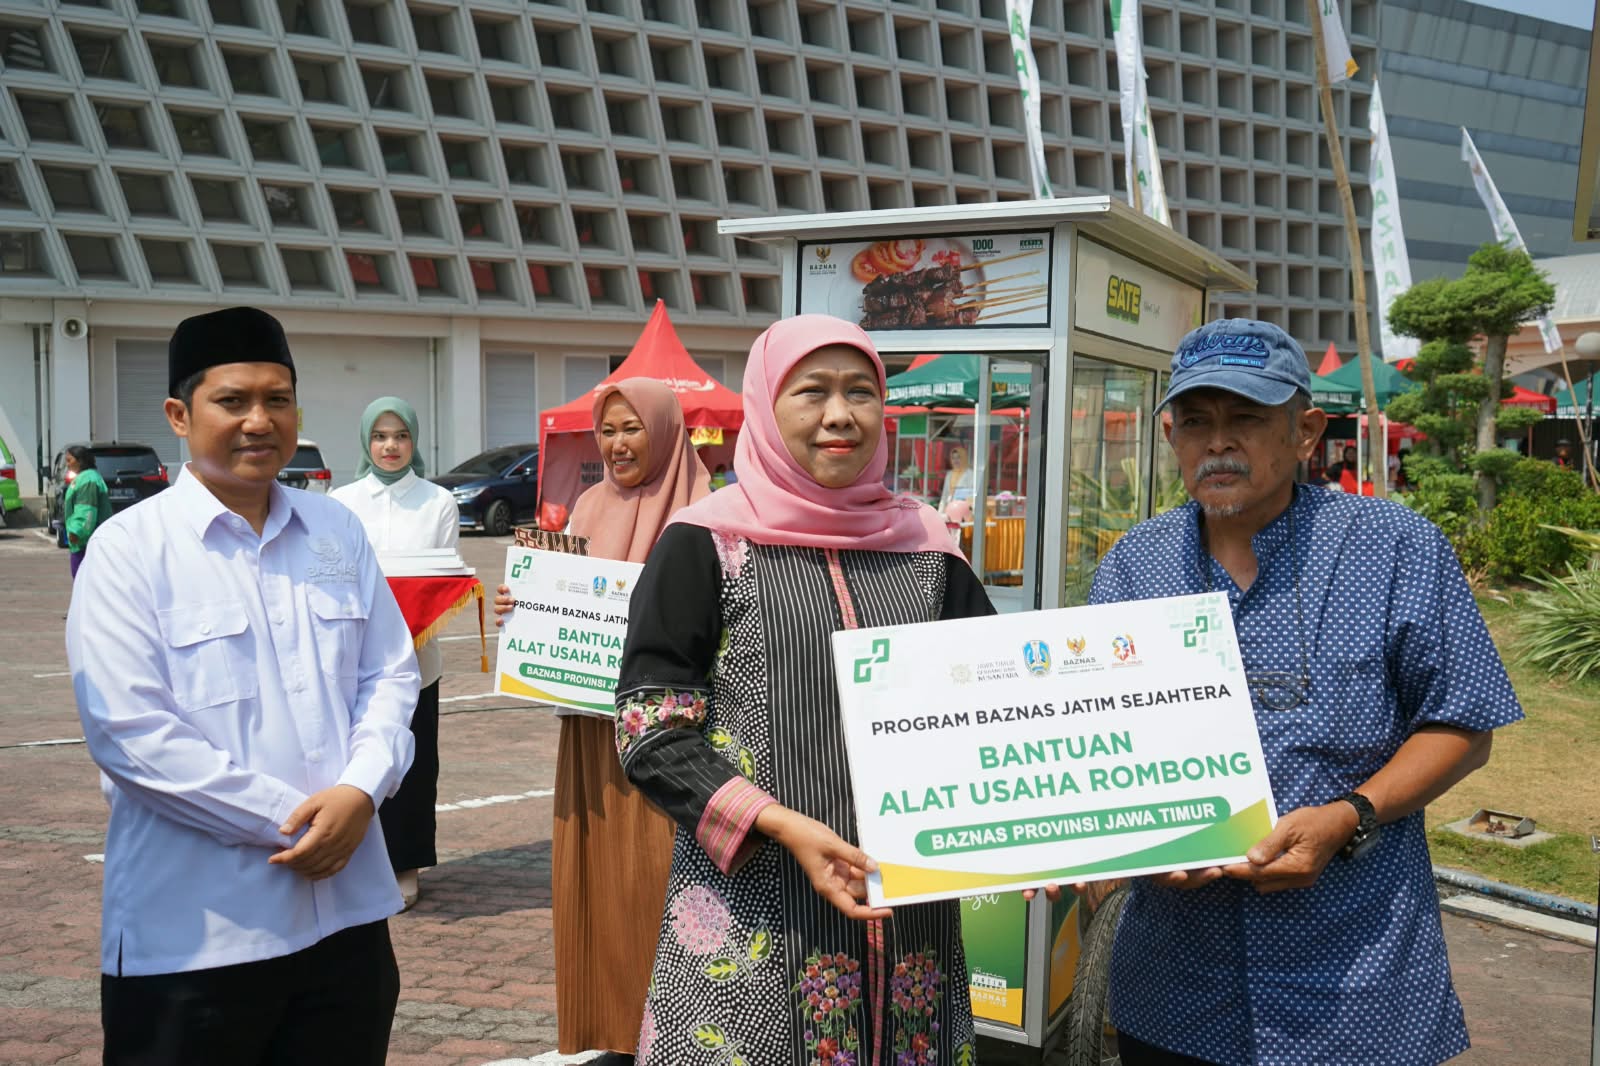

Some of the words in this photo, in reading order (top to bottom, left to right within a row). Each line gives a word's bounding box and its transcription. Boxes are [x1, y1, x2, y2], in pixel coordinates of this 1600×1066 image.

[972, 239, 994, 251] 1000
[1107, 275, 1141, 322] SATE
[513, 600, 560, 615] PROGRAM
[561, 607, 602, 621] BAZNAS
[507, 638, 546, 656] ALAT
[550, 645, 602, 666] USAHA
[558, 627, 625, 650] BANTUA
[1063, 657, 1097, 666] BAZNAS
[526, 666, 562, 681] BAZNAS
[564, 673, 606, 689] PROVINSI
[871, 713, 970, 736] PROGRAM
[975, 703, 1056, 725] BAZNAS
[1061, 696, 1116, 715] JATIM
[1120, 684, 1232, 709] SEJAHTERA
[978, 731, 1133, 770] BANTUAN
[879, 785, 959, 816] ALAT
[970, 772, 1080, 805] USAHA
[1089, 752, 1252, 791] ROMBONG
[931, 827, 1008, 850] BAZNAS
[1012, 816, 1100, 840] PROVINSI
[1105, 810, 1156, 830] JAWA
[1158, 803, 1217, 823] TIMUR
